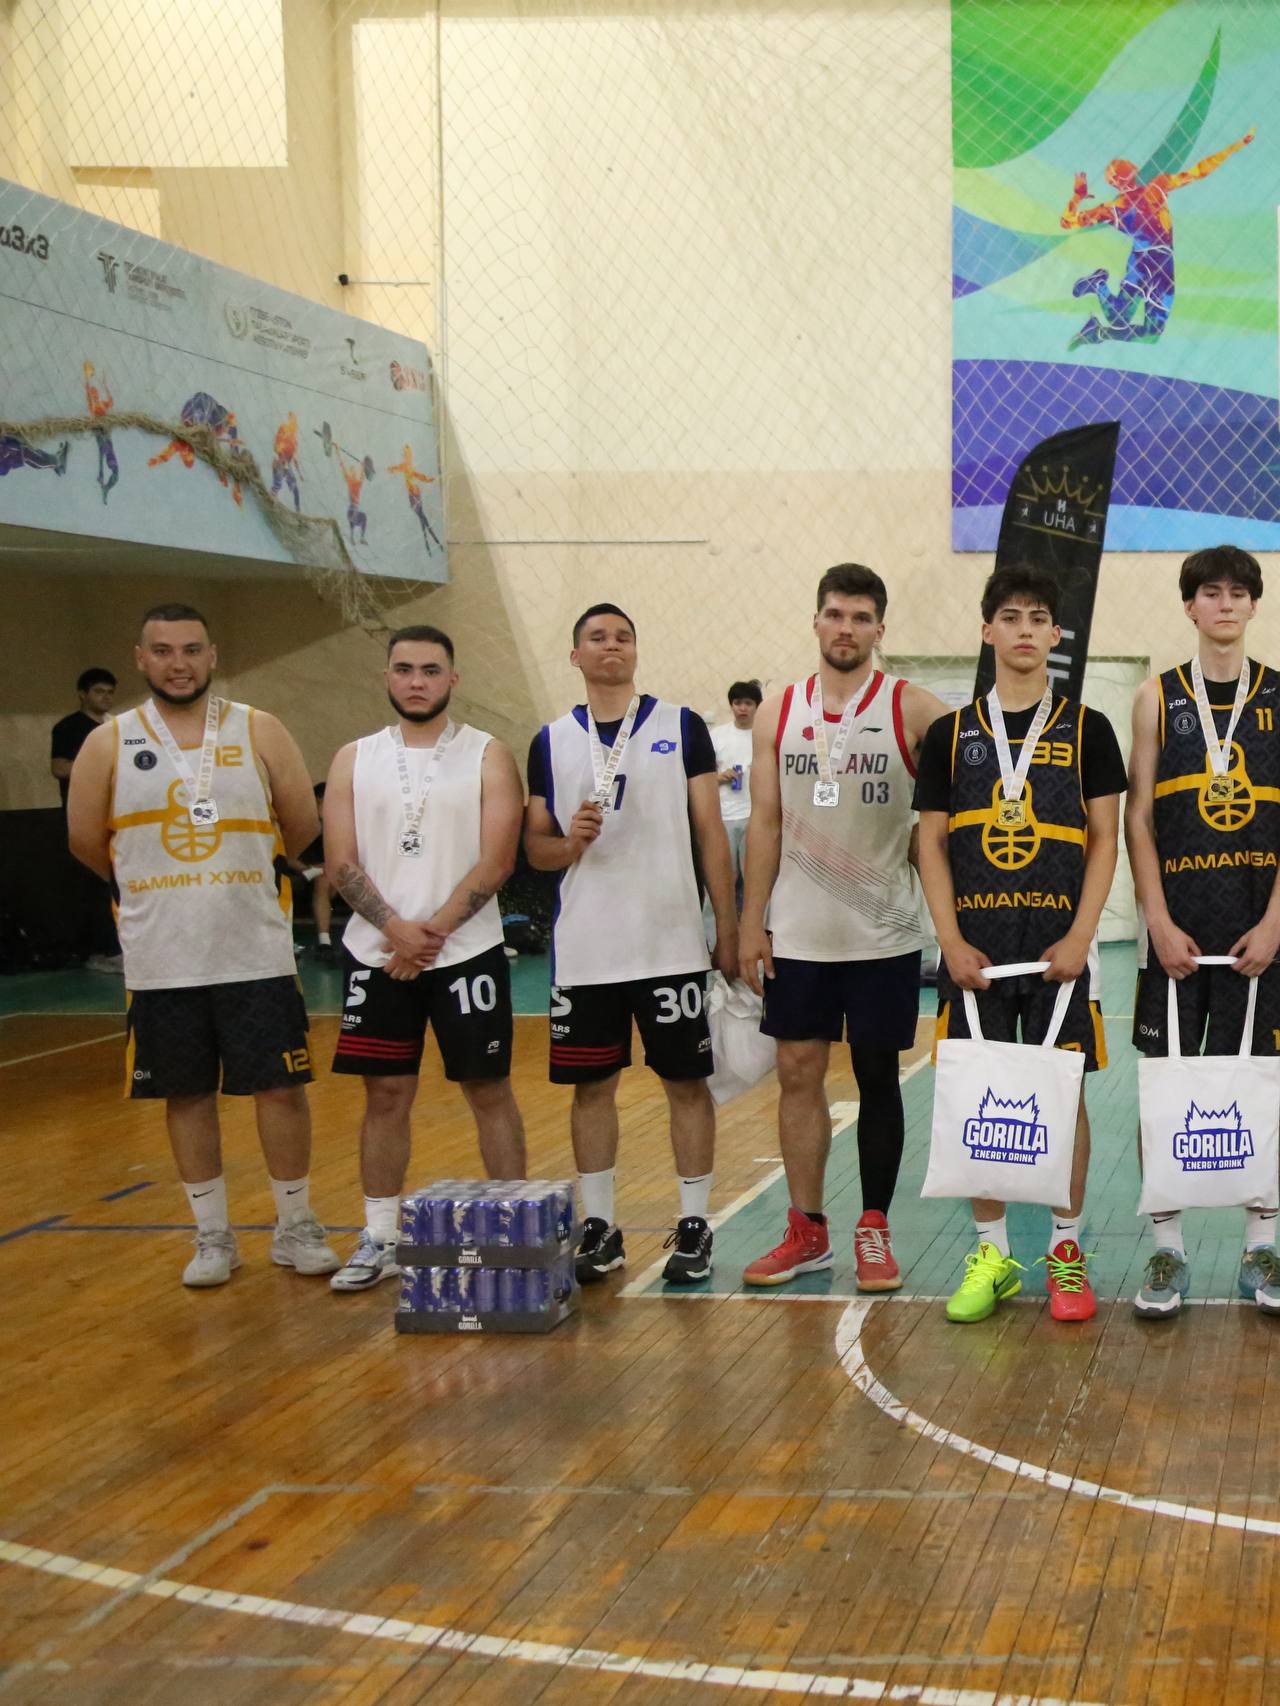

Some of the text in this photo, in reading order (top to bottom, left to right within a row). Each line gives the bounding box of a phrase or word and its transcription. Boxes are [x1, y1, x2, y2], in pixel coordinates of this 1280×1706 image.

[1043, 511, 1076, 532] UHA
[1168, 698, 1187, 710] ZDO
[1255, 707, 1273, 731] 11
[213, 745, 243, 768] 12
[784, 753, 889, 776] PORAND
[861, 781, 889, 804] 03
[1165, 850, 1277, 874] NAMANGA
[449, 974, 497, 1015] 10
[653, 981, 702, 1024] 30
[343, 1014, 362, 1024] ARS
[551, 1022, 571, 1034] ARS
[282, 1048, 310, 1073] 12
[966, 1121, 1046, 1152] GORILLA
[1175, 1131, 1252, 1159] GORILLA
[974, 1149, 1034, 1163] ENERGY DRINK
[1186, 1158, 1243, 1170] ENERGY DRINK
[458, 1255, 483, 1264] GORILLA
